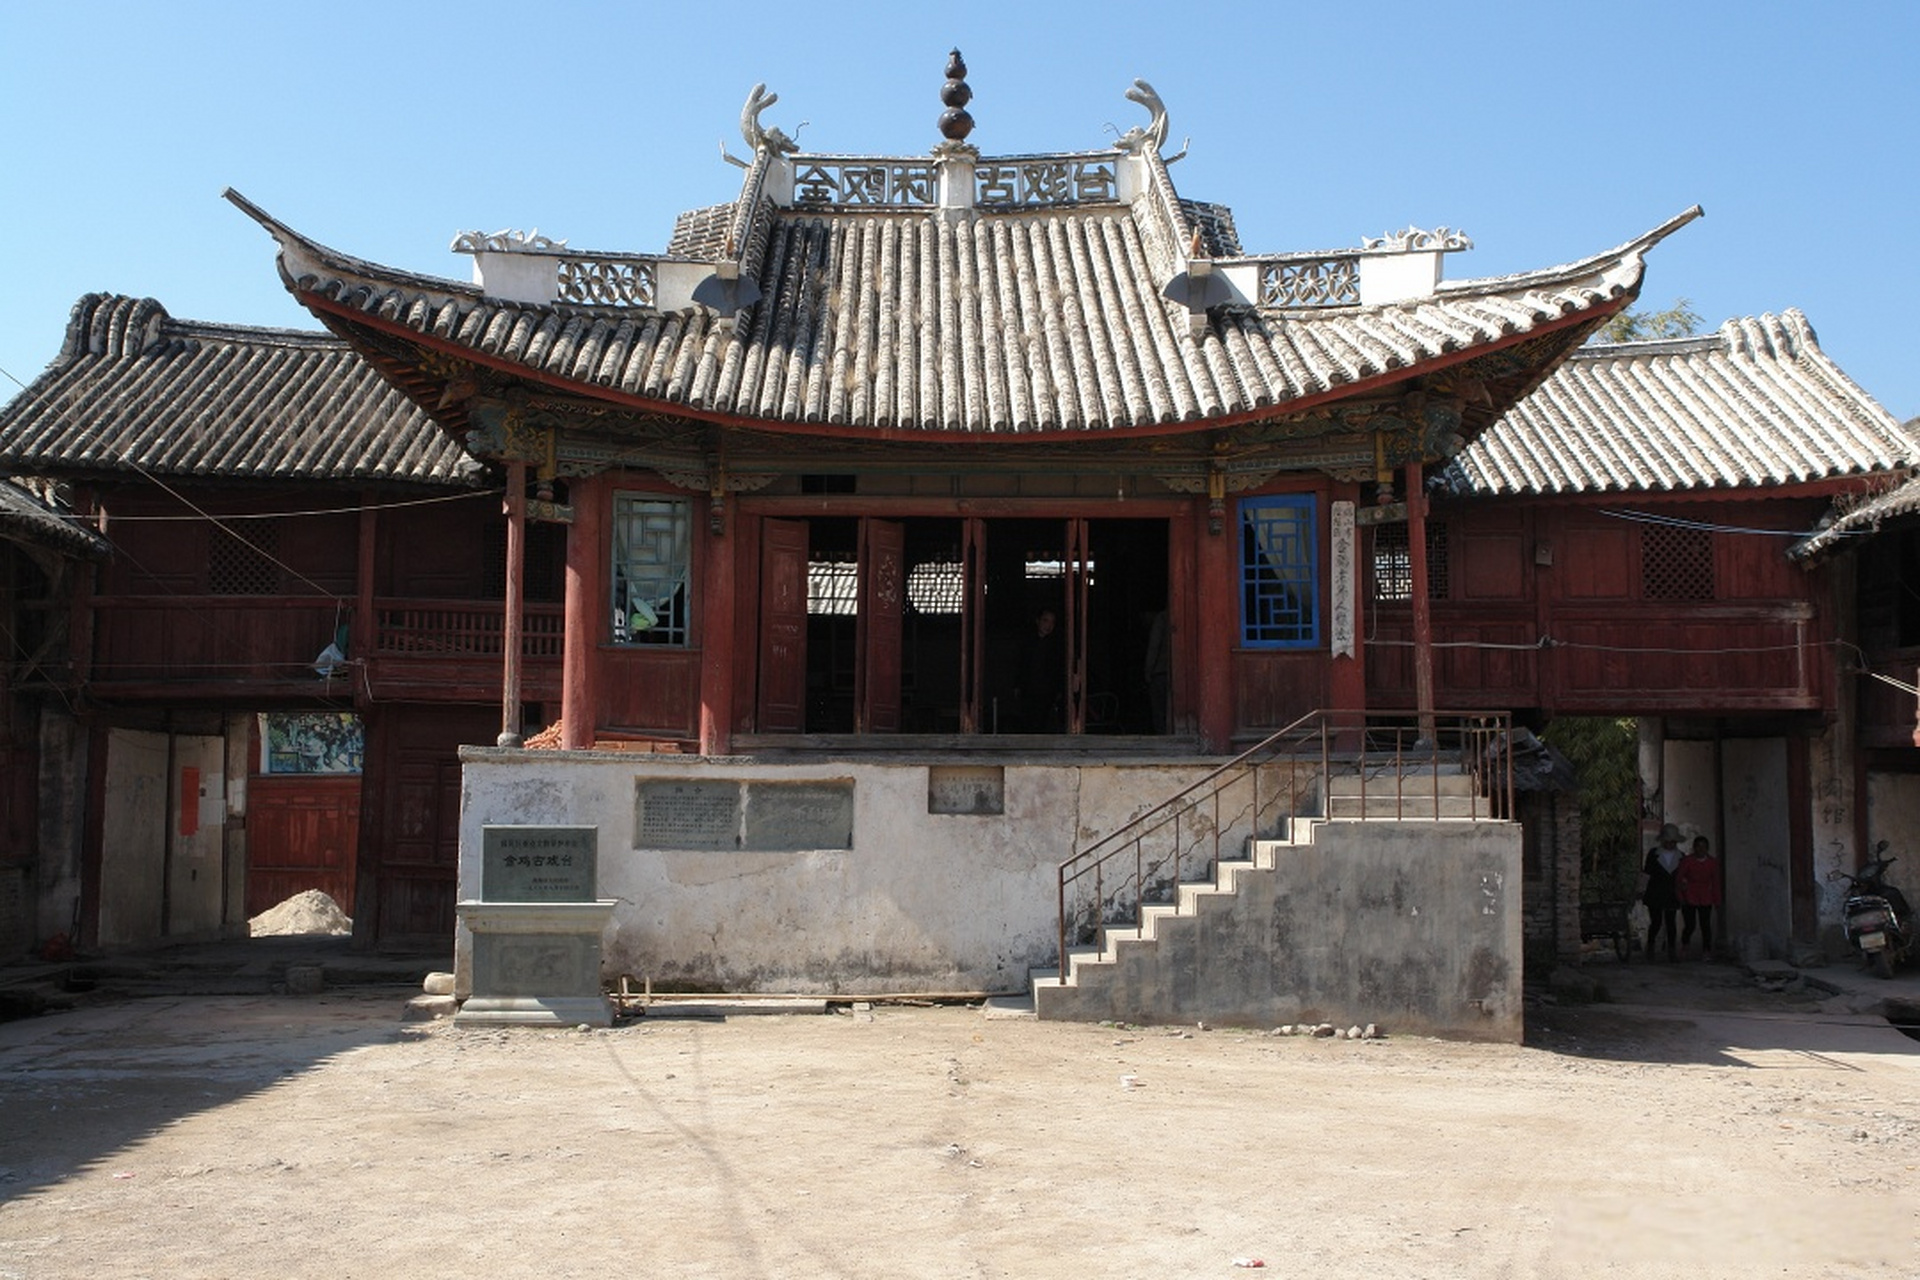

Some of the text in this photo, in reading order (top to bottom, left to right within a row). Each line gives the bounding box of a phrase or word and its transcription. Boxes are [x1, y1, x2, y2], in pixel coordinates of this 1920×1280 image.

[794, 162, 1115, 204] 金鸡村 古戏台
[503, 854, 572, 867] 金鸡古戏台
